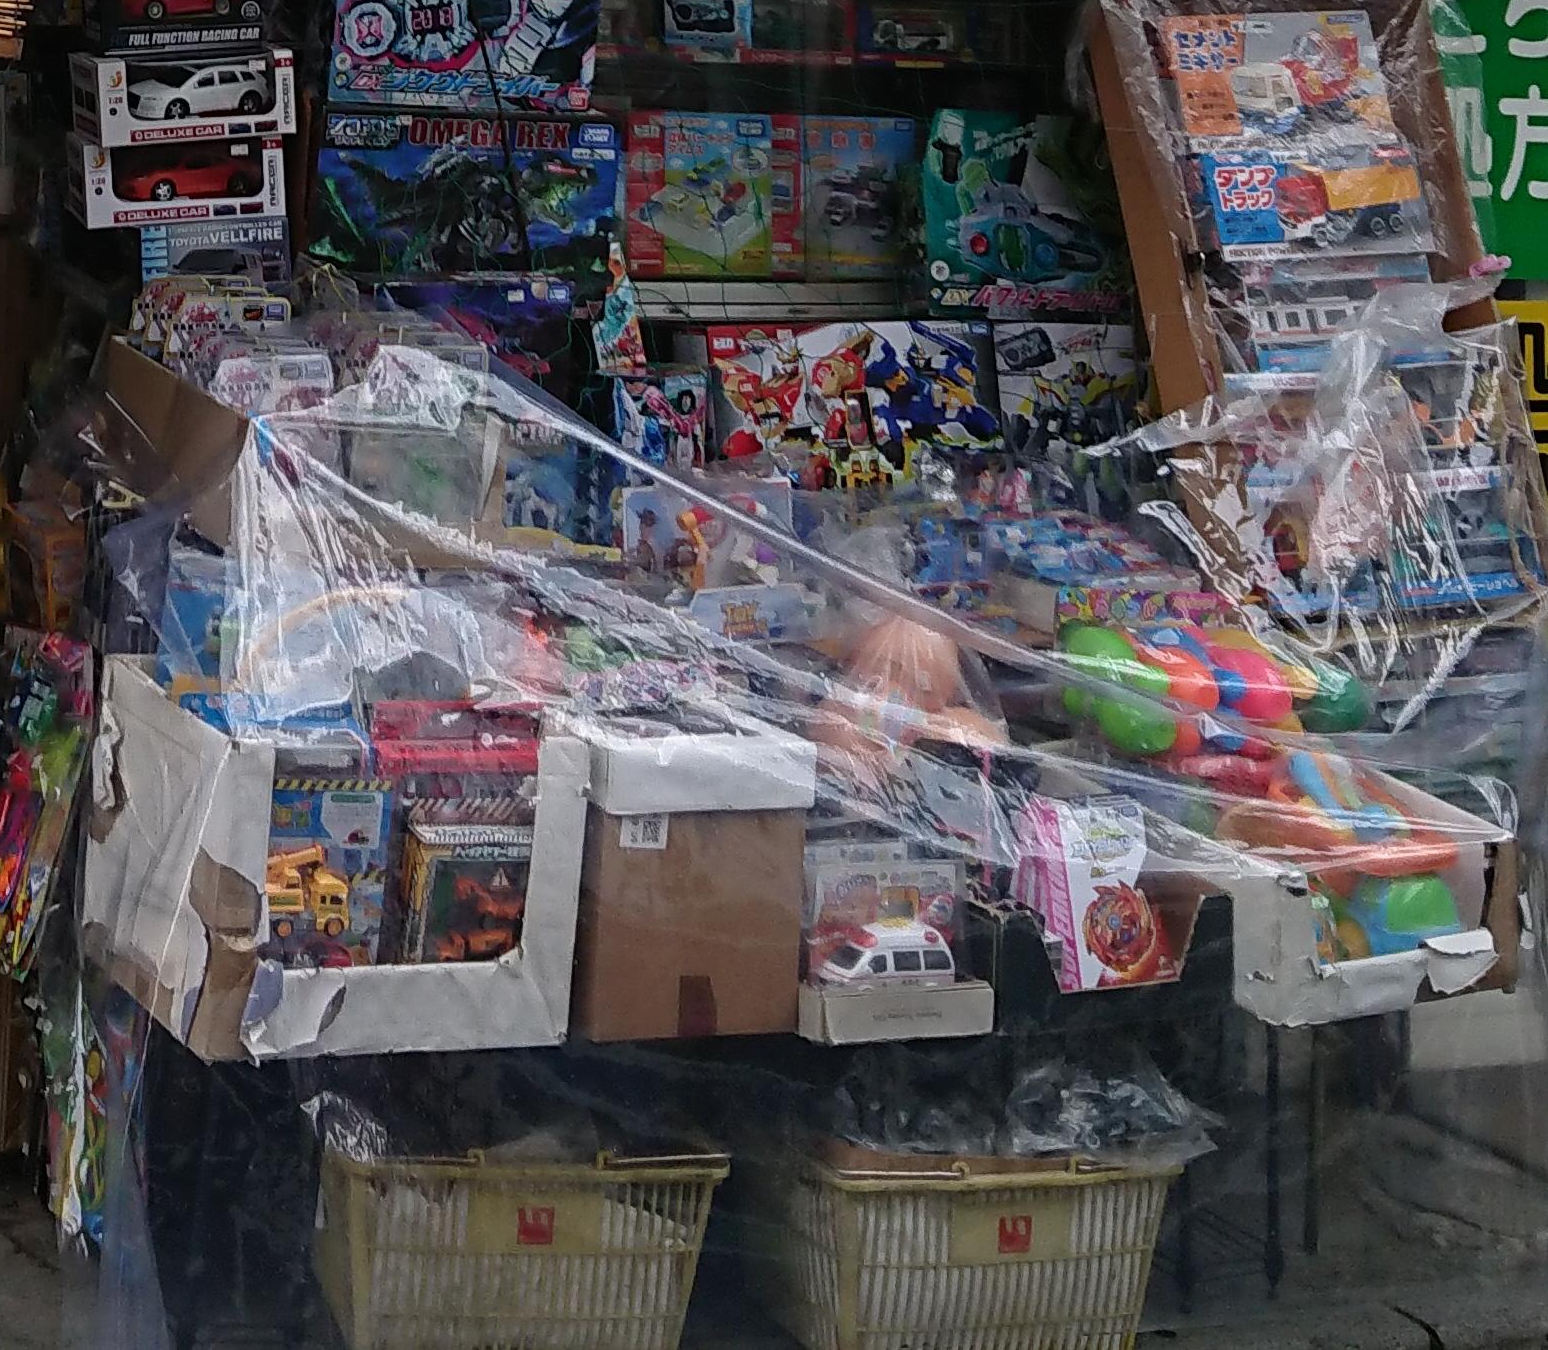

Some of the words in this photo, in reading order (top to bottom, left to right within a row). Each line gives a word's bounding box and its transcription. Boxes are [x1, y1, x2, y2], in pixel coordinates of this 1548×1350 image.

[128, 33, 151, 47] FULL
[151, 30, 201, 46] FUNCTION
[200, 28, 240, 44] RACING
[239, 27, 261, 41] CAR
[1172, 29, 1237, 50] セメント
[1176, 51, 1241, 73] ミキサー
[144, 127, 195, 141] DELUXE
[195, 125, 223, 137] CAR
[407, 117, 510, 149] OMEGA
[514, 120, 571, 150] REX
[1214, 165, 1276, 190] ダンプ
[1219, 189, 1275, 212] トラック
[127, 209, 179, 222] DELUXE
[179, 207, 208, 219] CAR
[169, 235, 210, 248] TOYOTA
[209, 227, 284, 245] VELLFIRE
